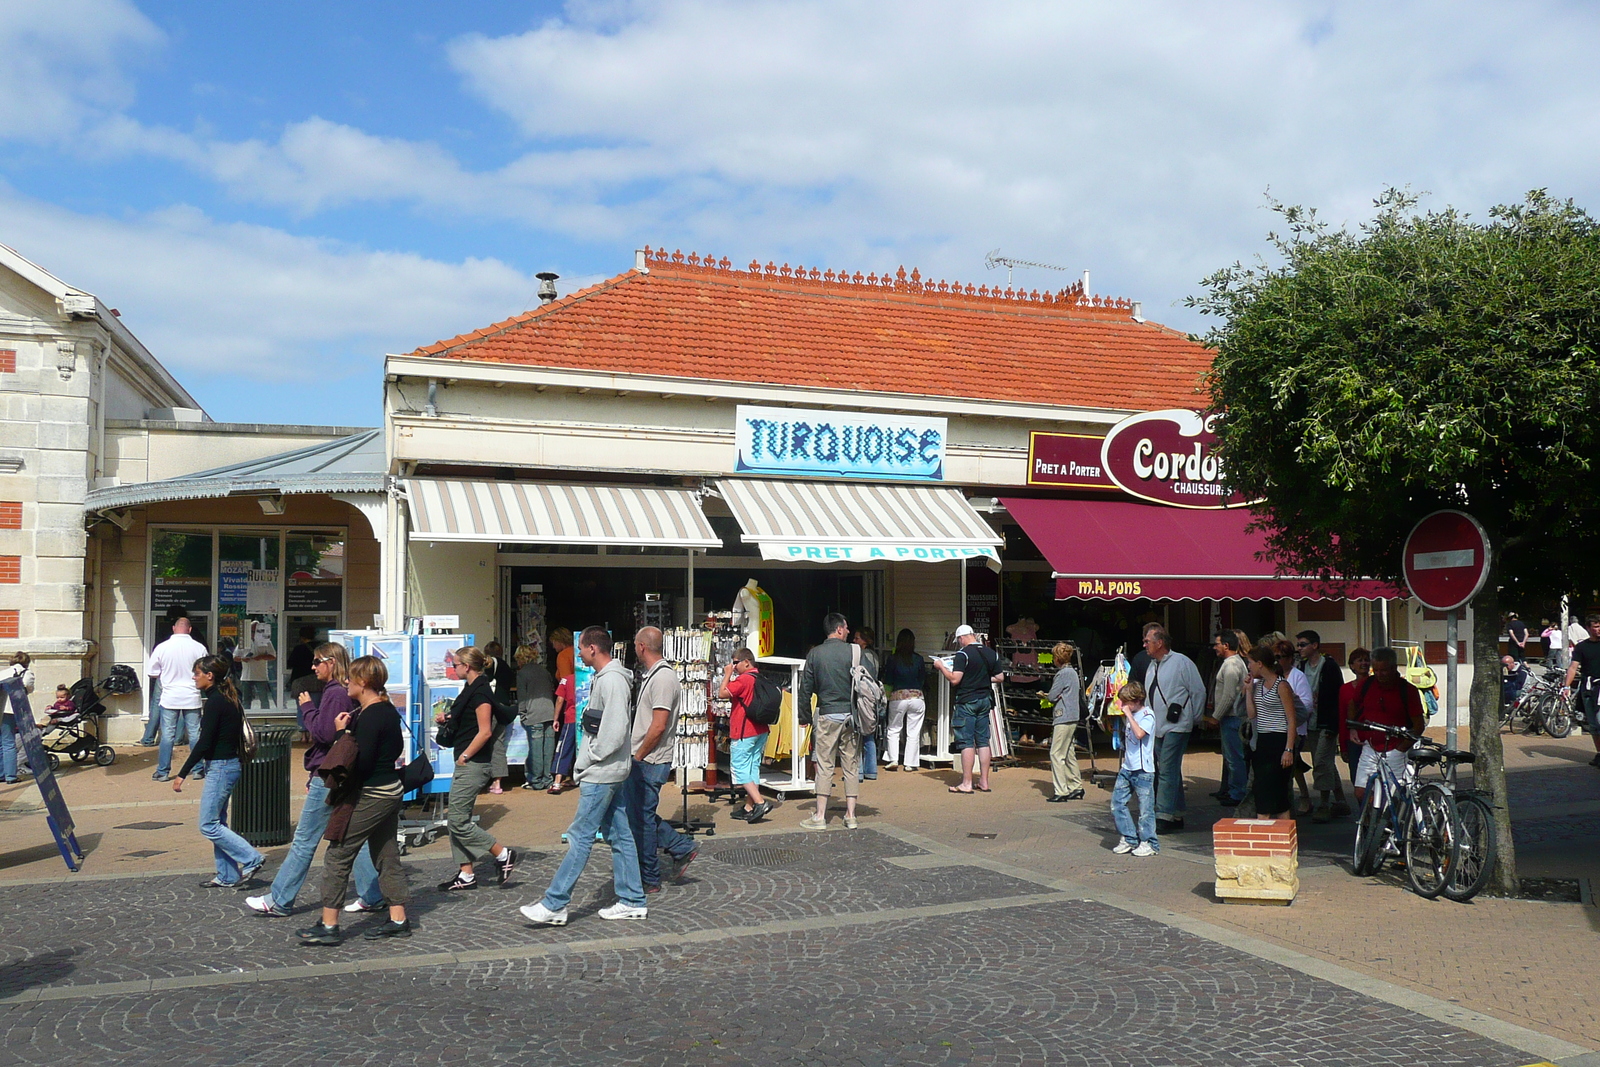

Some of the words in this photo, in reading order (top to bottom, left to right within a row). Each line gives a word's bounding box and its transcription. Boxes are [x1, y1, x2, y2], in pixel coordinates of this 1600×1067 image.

[745, 417, 942, 467] TURQUOISE
[1035, 458, 1059, 474] PRET
[1060, 464, 1067, 475] A
[1069, 461, 1101, 477] PORTER
[788, 546, 853, 559] PRET
[870, 547, 886, 558] A
[895, 546, 995, 559] PORTER
[223, 576, 247, 584] Vivald
[247, 569, 279, 582] RUGBY
